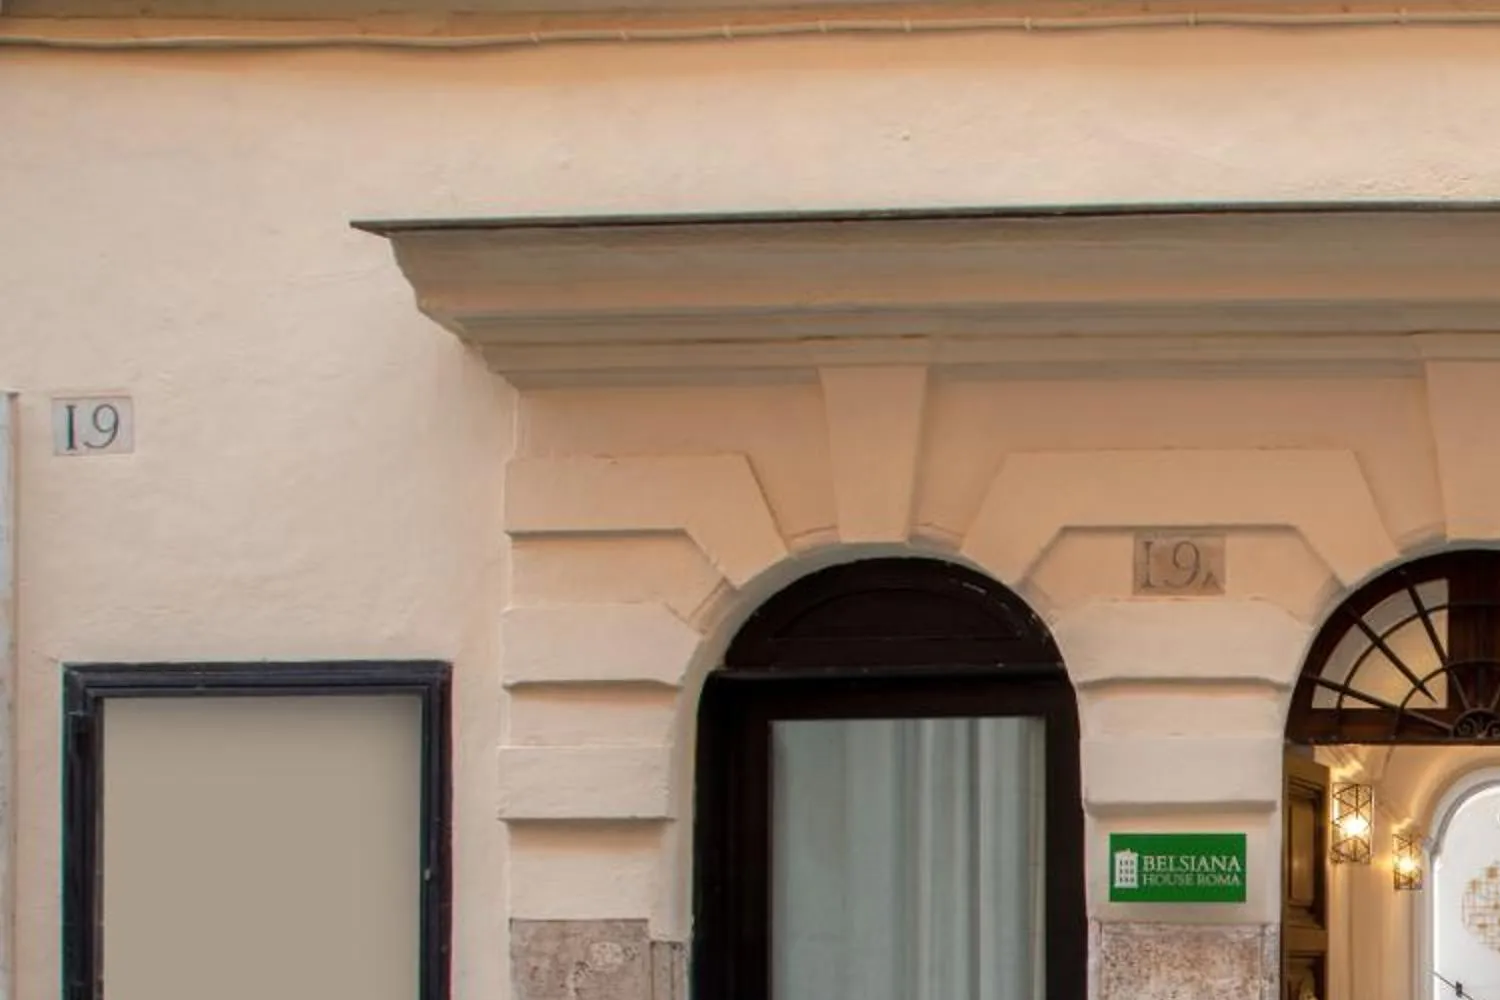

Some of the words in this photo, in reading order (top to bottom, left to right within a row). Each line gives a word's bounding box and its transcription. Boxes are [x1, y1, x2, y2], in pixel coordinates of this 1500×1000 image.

[65, 404, 119, 450] 19
[1142, 855, 1242, 872] BELSIANA
[1142, 873, 1194, 887] HOUSE
[1196, 873, 1242, 887] ROMA
